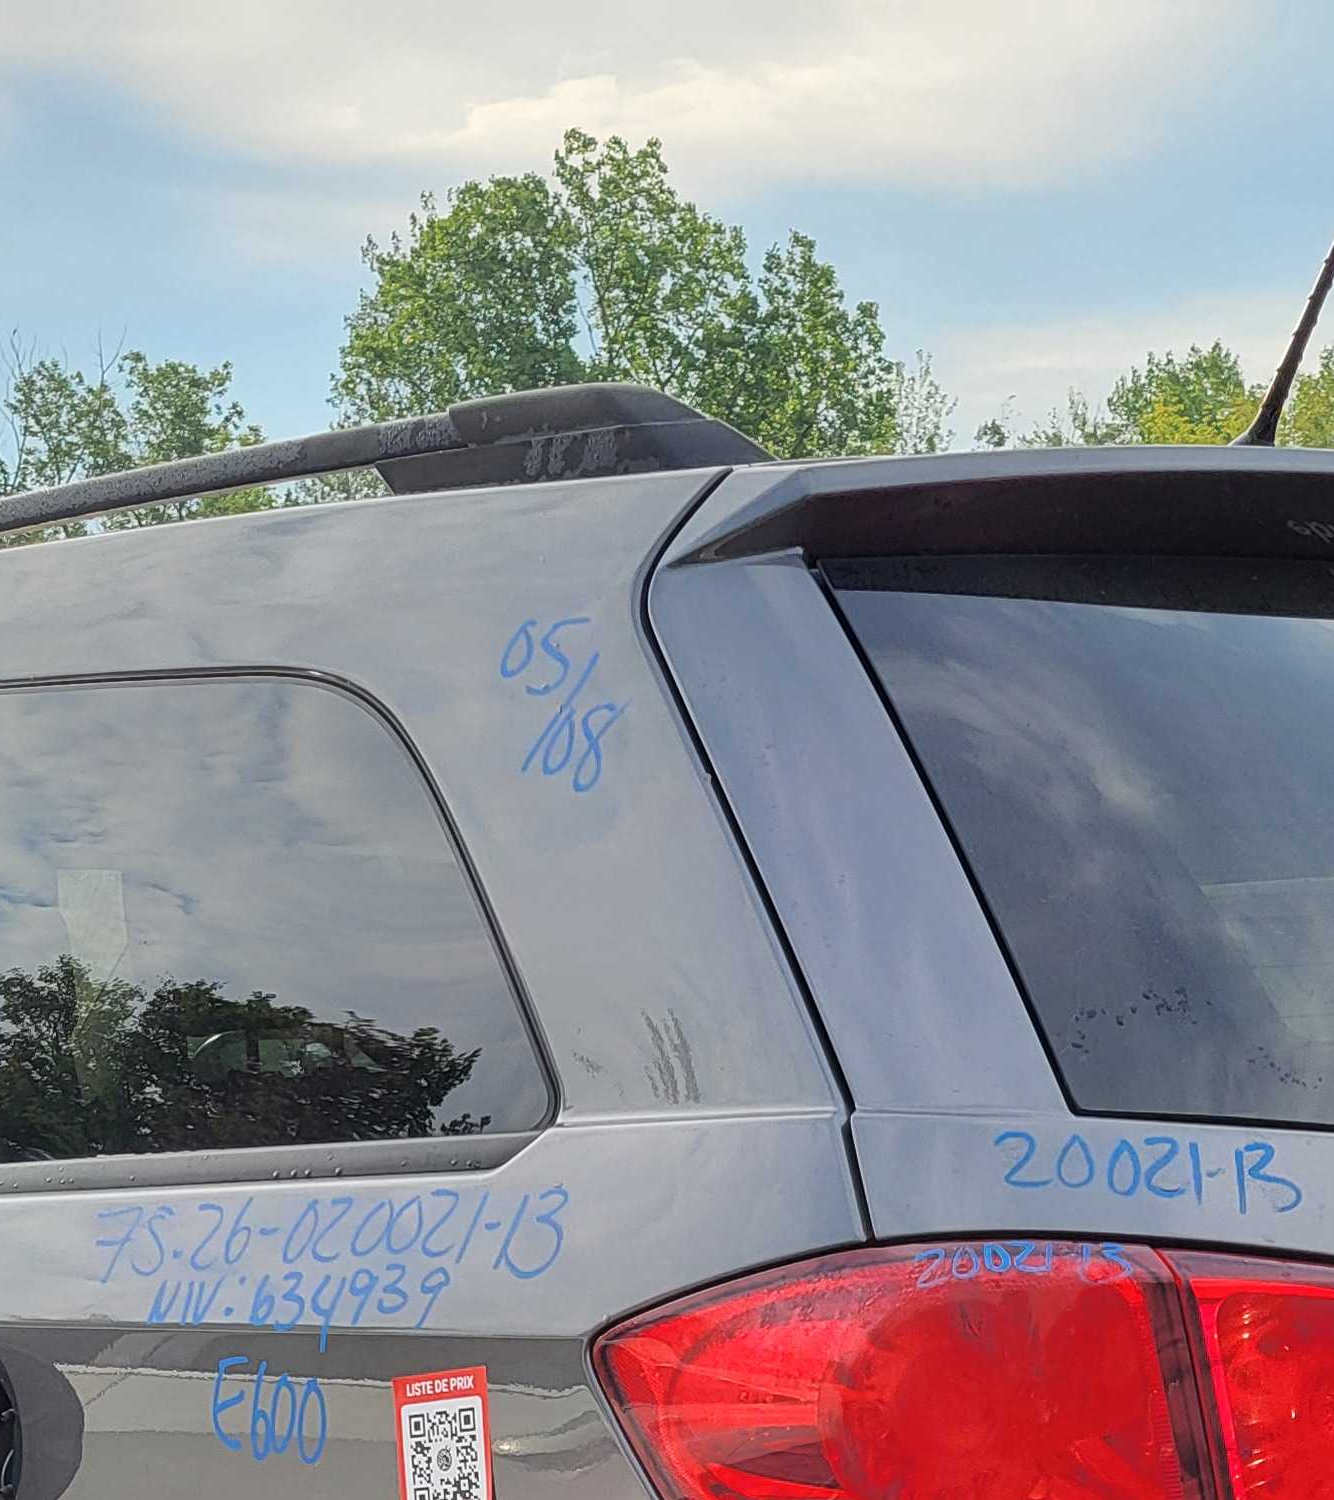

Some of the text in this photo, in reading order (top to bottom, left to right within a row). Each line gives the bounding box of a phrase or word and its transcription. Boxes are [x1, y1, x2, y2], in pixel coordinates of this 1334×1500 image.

[211, 1356, 328, 1466] E600
[406, 1374, 475, 1398] LISTE DE PRIX
